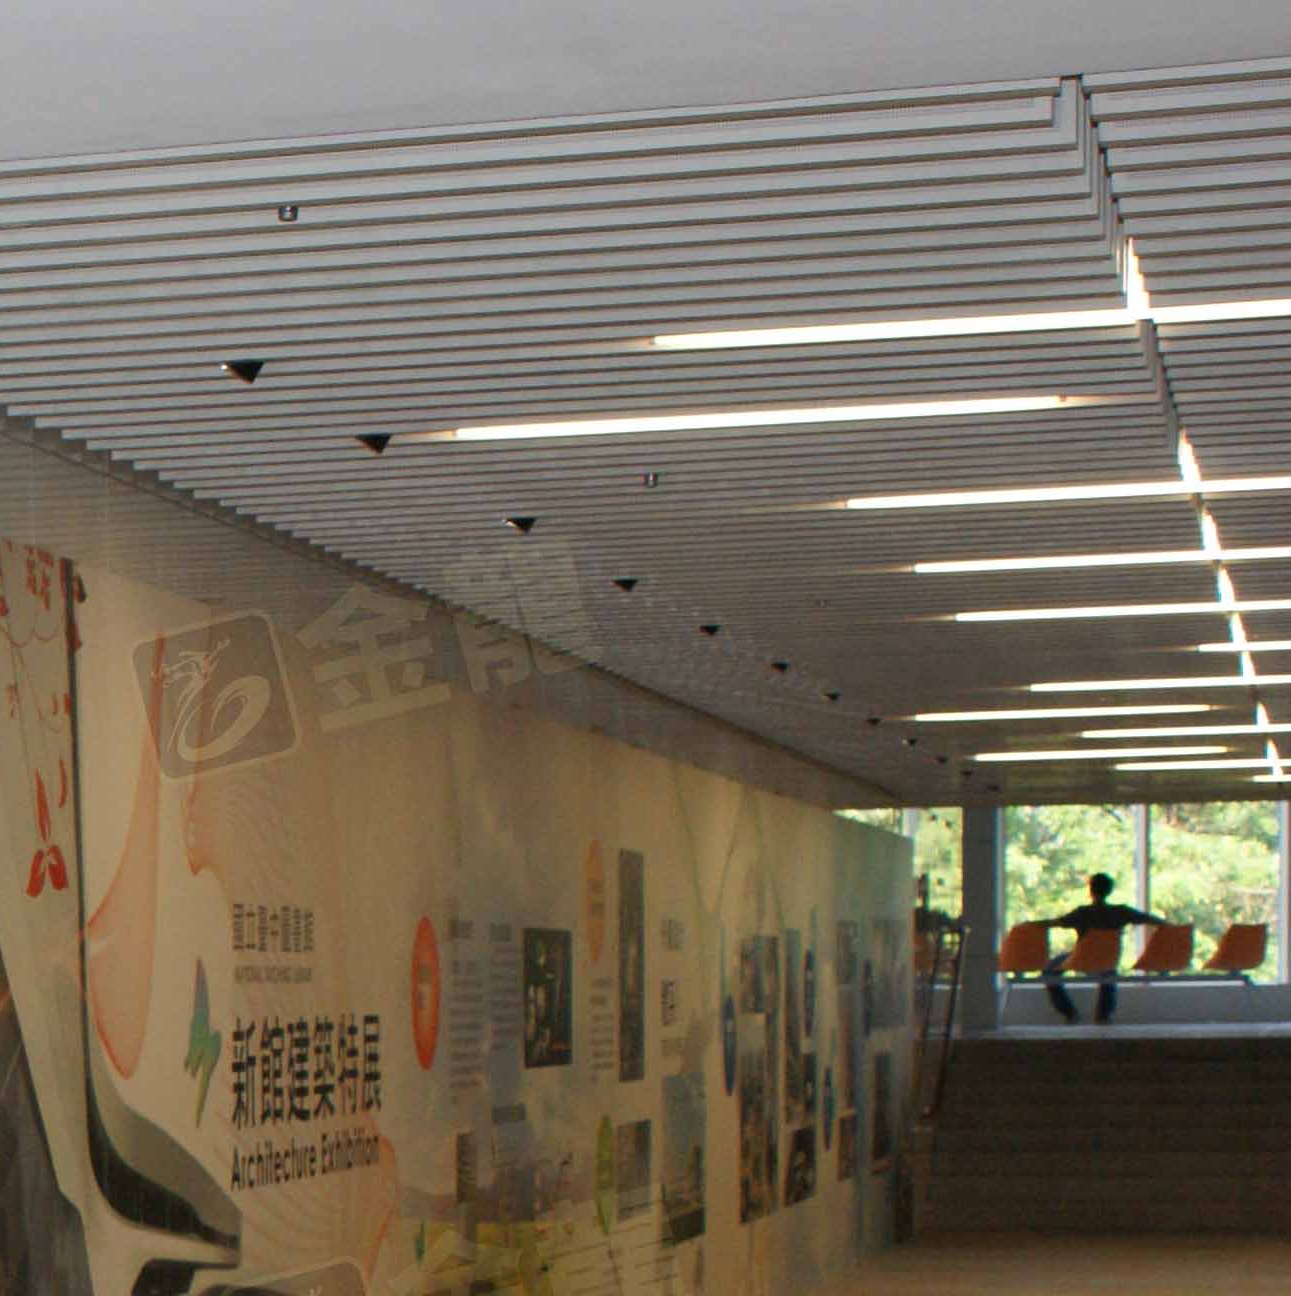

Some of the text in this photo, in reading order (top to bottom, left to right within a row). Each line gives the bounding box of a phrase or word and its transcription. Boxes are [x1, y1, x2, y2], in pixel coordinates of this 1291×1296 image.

[231, 1013, 382, 1130] 新館建築特展
[230, 1128, 380, 1192] Architecture Exhibition
